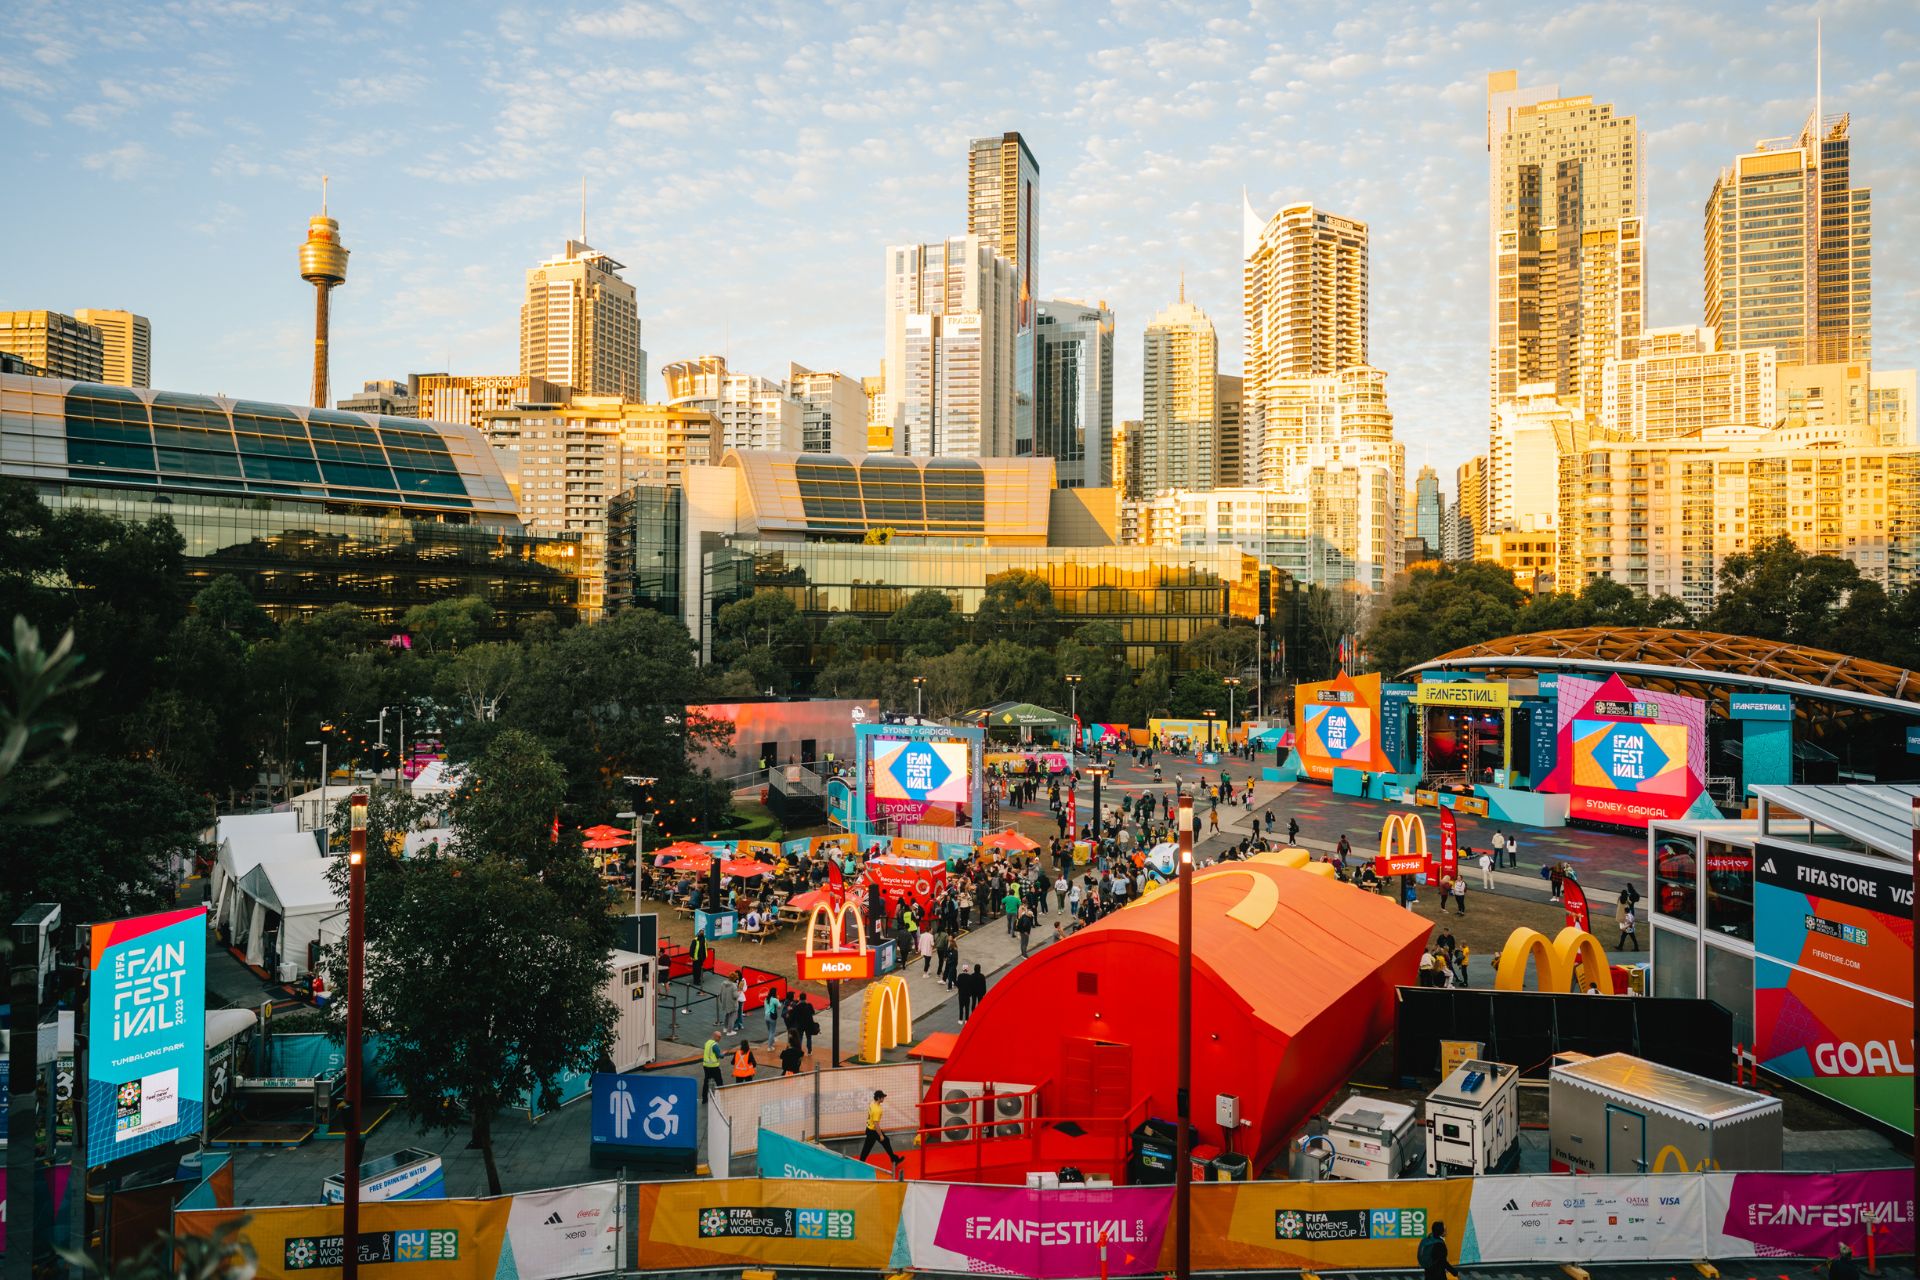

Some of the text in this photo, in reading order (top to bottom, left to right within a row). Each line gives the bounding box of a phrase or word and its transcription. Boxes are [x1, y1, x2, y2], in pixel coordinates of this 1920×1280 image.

[1536, 101, 1564, 110] WORLD
[1328, 726, 1347, 738] FEST
[1618, 734, 1643, 750] FAN
[1614, 748, 1644, 764] FEST
[907, 764, 932, 777] FEST
[885, 804, 922, 812] SYDNEY
[1586, 799, 1668, 817] SYDNEY GADIGAL
[1797, 866, 1877, 898] FIFA STORE
[1888, 886, 1914, 906] VIS
[1844, 926, 1854, 934] AU
[1856, 928, 1866, 937] 20
[116, 940, 184, 980] FIFA FAN
[1812, 948, 1861, 970] FIFASTORE.COM
[821, 962, 851, 972] McDo
[114, 969, 186, 1010] FEST
[175, 999, 184, 1026] 2023
[112, 1042, 184, 1066] TUMBALONG PARK
[1556, 1147, 1566, 1158] I'm
[369, 1166, 427, 1192] FREE DRINKING WATER
[1659, 1197, 1680, 1205] VISA
[730, 1209, 753, 1218] FIFA
[799, 1212, 823, 1224] AU
[828, 1212, 852, 1224] 20
[1306, 1214, 1328, 1222] FIFA
[1372, 1212, 1396, 1224] AU
[1401, 1212, 1425, 1223] 20
[730, 1226, 782, 1235] WORLD CUP
[799, 1224, 823, 1236] NZ
[828, 1226, 852, 1237] 23
[966, 1216, 974, 1239] FIFA
[1136, 1219, 1144, 1242] 2023
[1306, 1222, 1348, 1230] WOMEN'S
[1373, 1224, 1396, 1236] NZ
[1401, 1224, 1425, 1236] 23
[398, 1232, 424, 1245] AU
[430, 1232, 457, 1244] 20
[565, 1230, 586, 1239] xero
[320, 1238, 344, 1248] FIFA
[358, 1253, 380, 1261] CUP
[398, 1246, 424, 1259] NZ
[430, 1245, 456, 1258] 23
